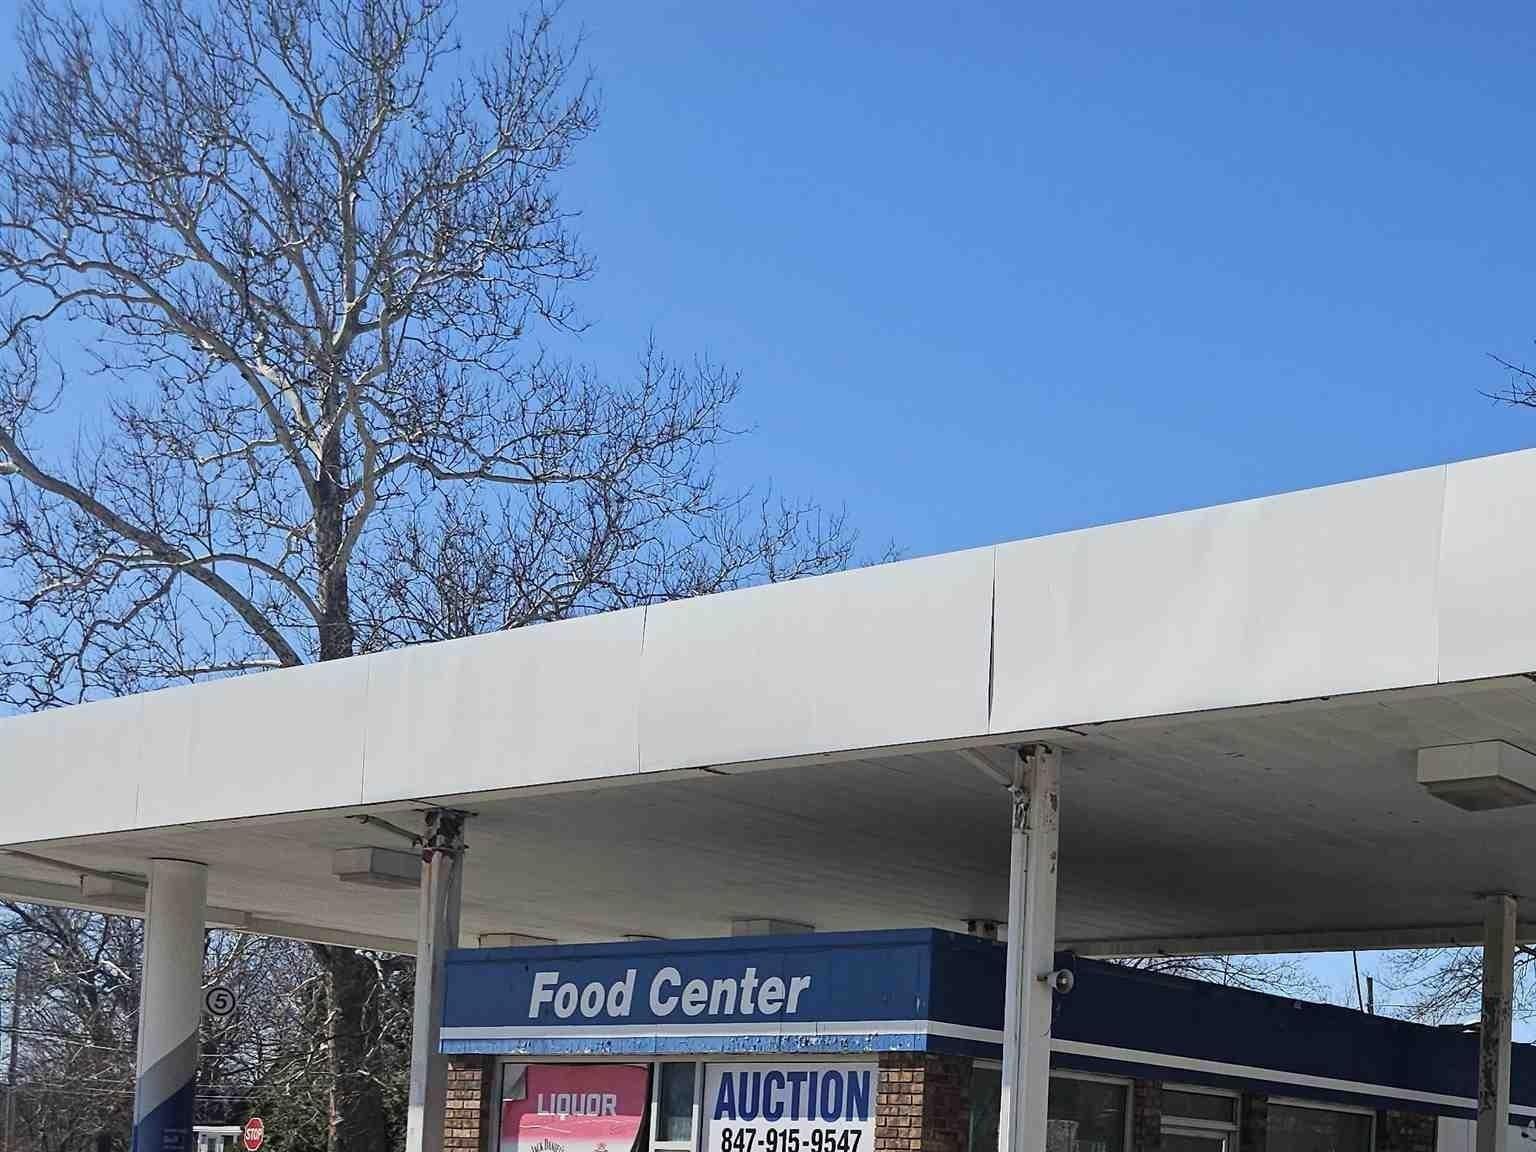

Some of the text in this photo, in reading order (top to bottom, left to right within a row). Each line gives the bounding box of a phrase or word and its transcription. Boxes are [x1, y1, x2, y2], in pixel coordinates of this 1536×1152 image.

[214, 993, 228, 1009] 5
[528, 966, 811, 1019] Food Center
[537, 1093, 617, 1119] LIQUOR
[714, 1070, 871, 1122] AUCTION
[245, 1129, 263, 1141] STOP
